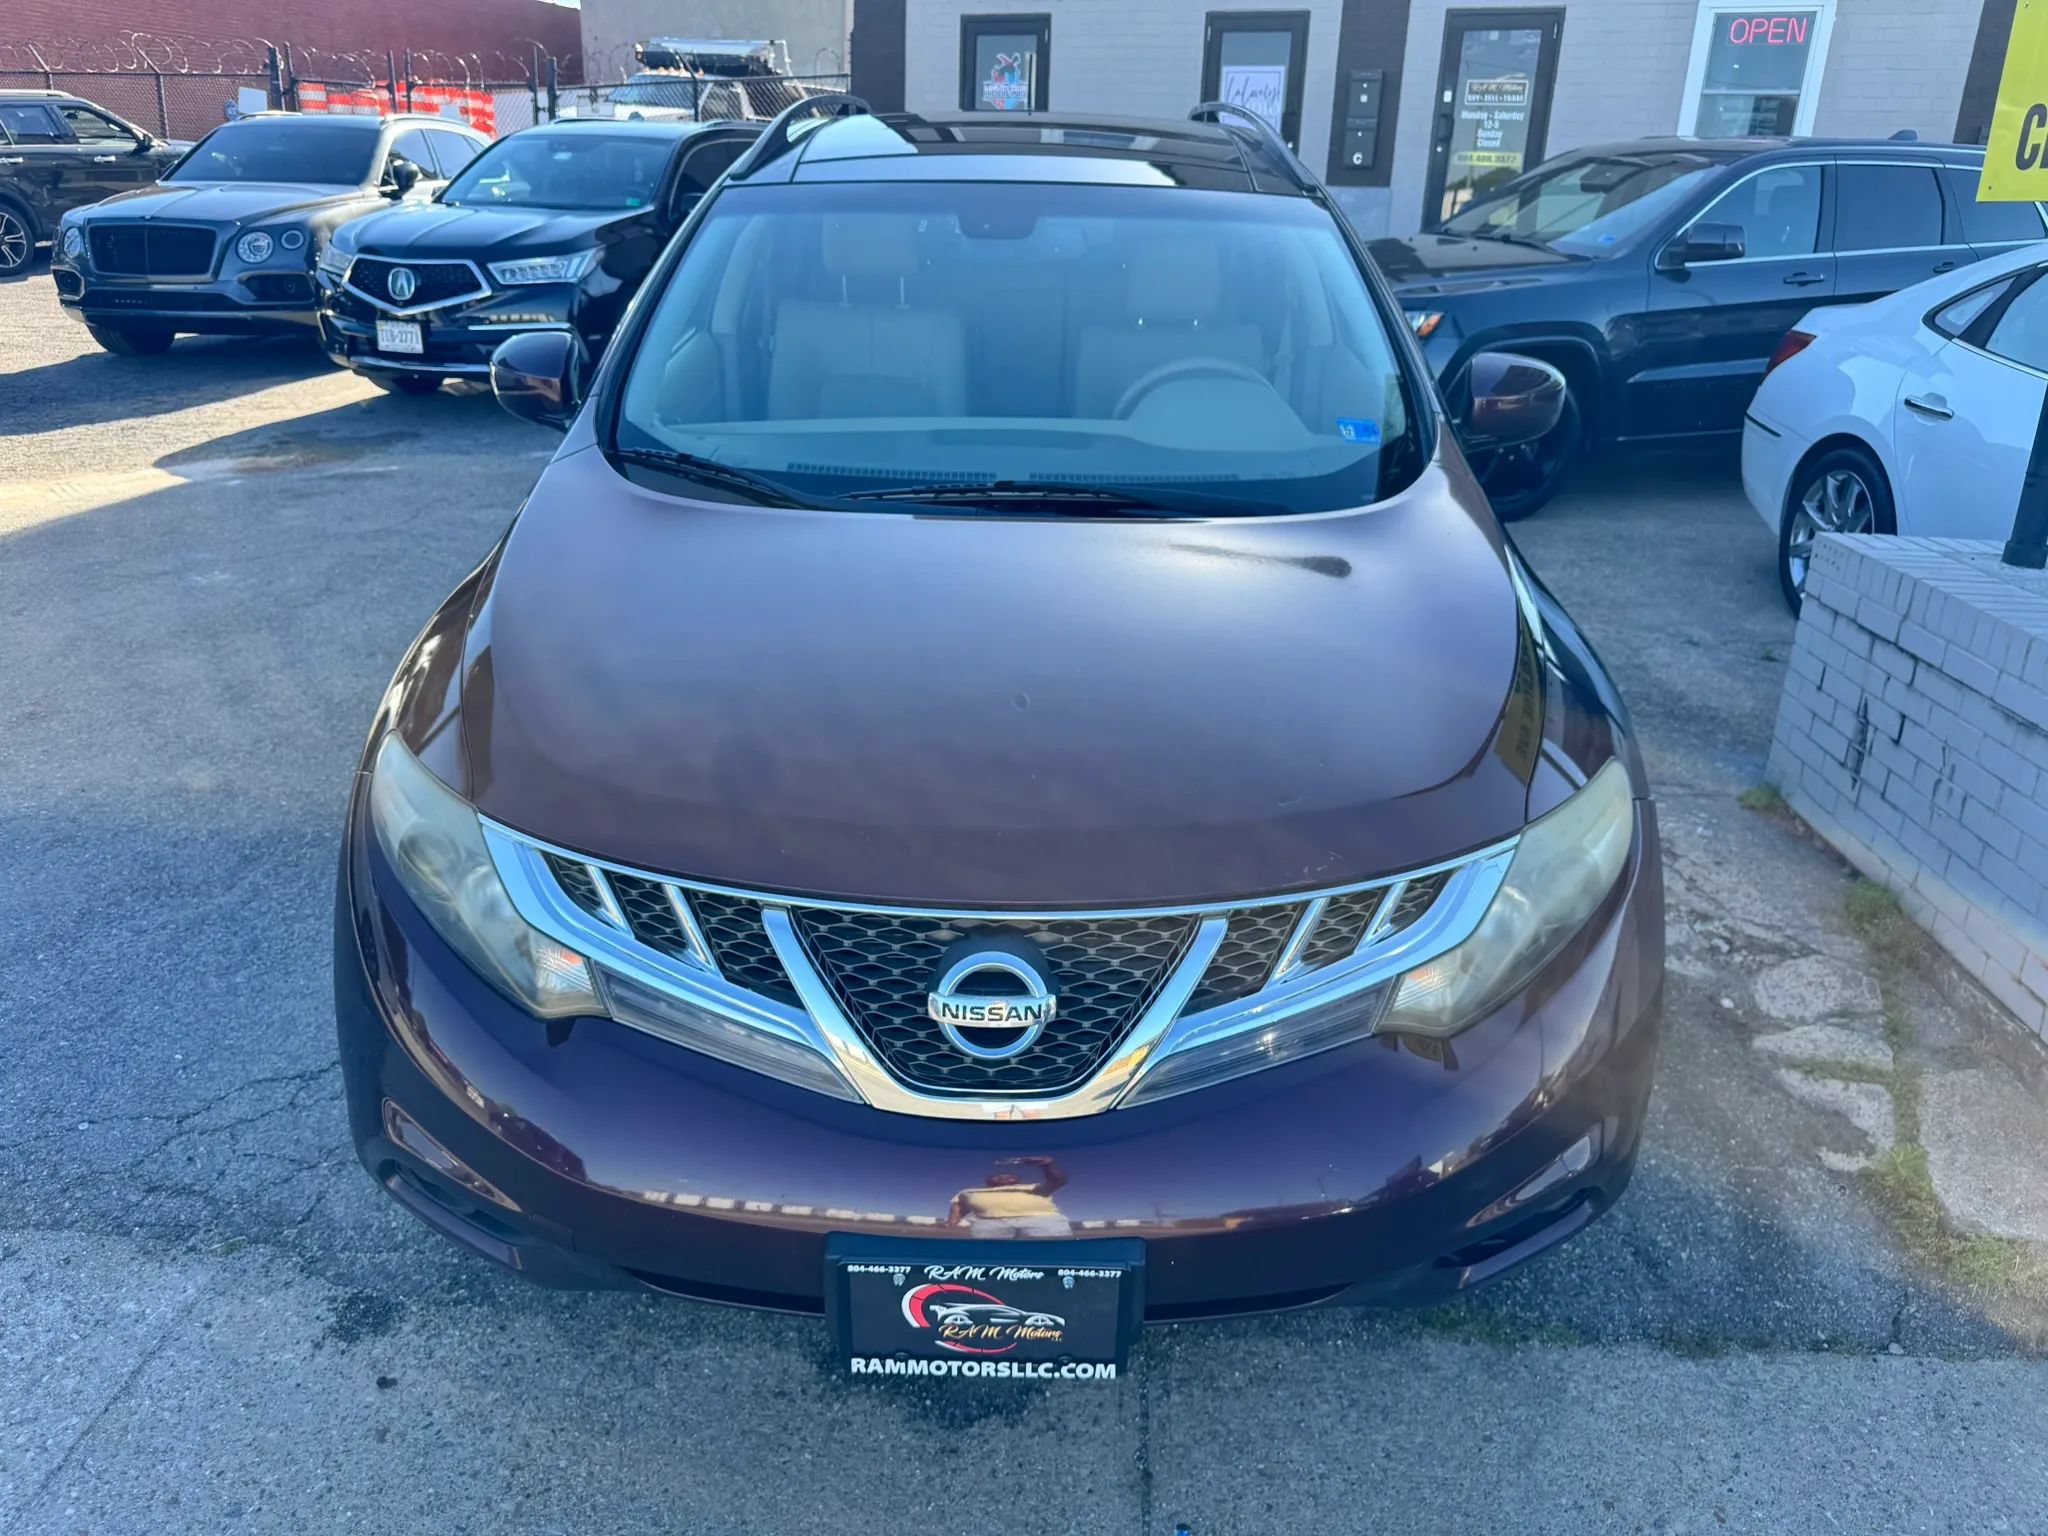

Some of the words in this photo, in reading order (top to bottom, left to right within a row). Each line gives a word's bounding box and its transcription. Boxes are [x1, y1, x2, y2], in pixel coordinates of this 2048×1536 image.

[1729, 17, 1807, 44] OPEN
[942, 1002, 1042, 1021] NISSAN
[847, 1265, 911, 1274] 804-466-3377
[923, 1265, 987, 1281] RAM
[989, 1266, 1045, 1281] Motors
[1058, 1269, 1122, 1278] 804-466-3377
[938, 1324, 1003, 1340] RAM
[1006, 1324, 1064, 1339] Motors
